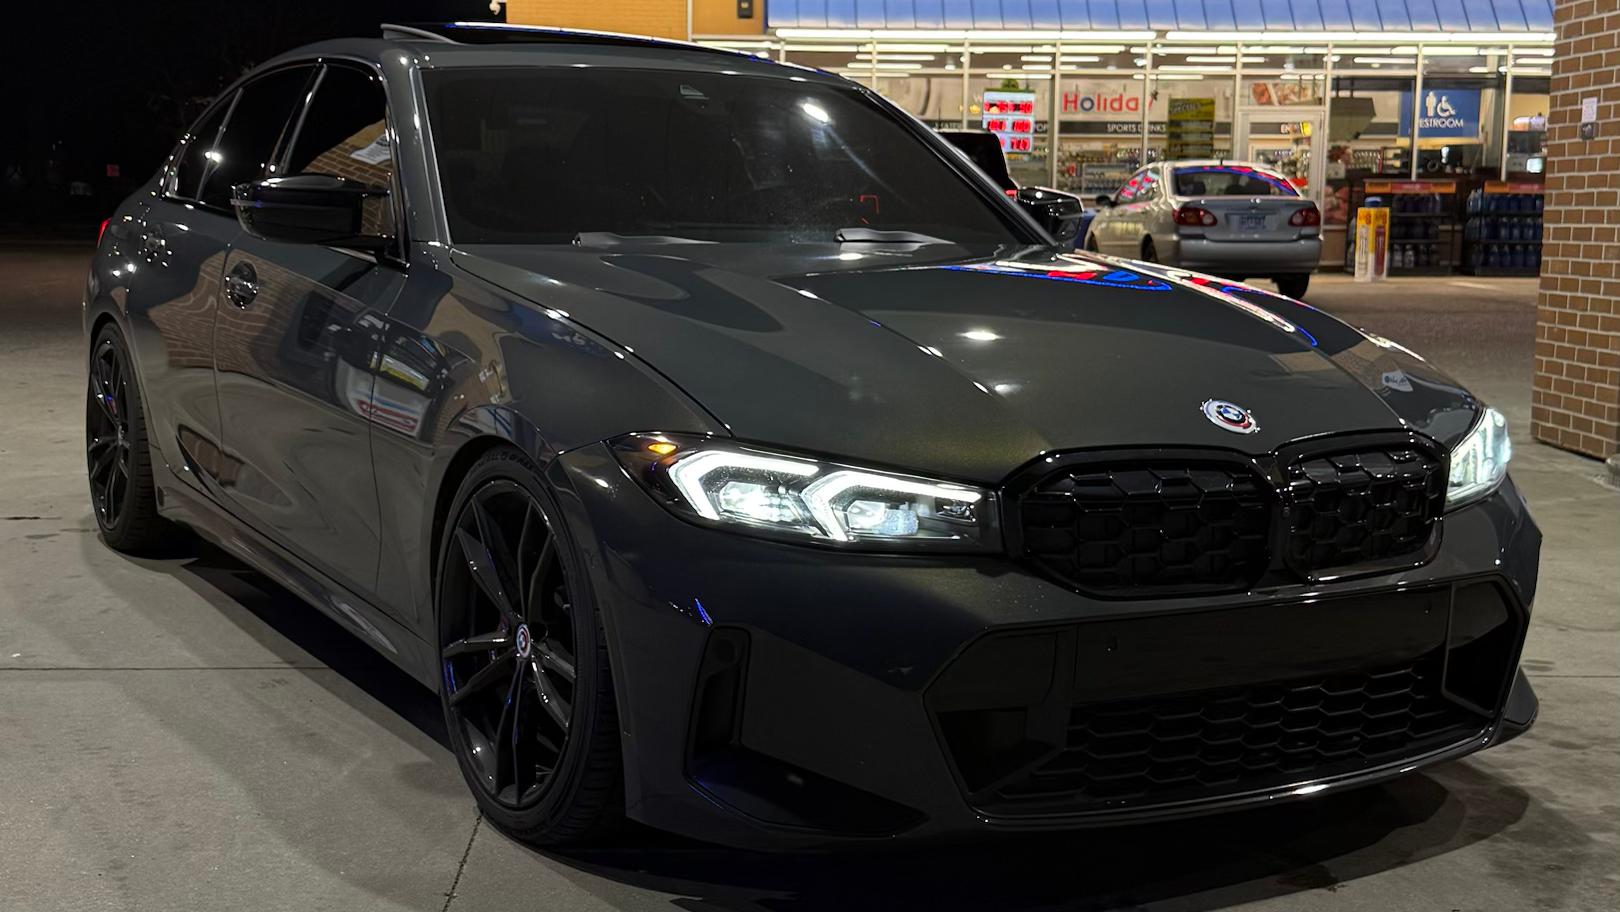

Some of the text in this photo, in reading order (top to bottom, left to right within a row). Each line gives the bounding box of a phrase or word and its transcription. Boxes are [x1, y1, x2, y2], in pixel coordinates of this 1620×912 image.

[1107, 123, 1166, 133] SPORTS DNKS
[1418, 118, 1464, 129] ESTROOM
